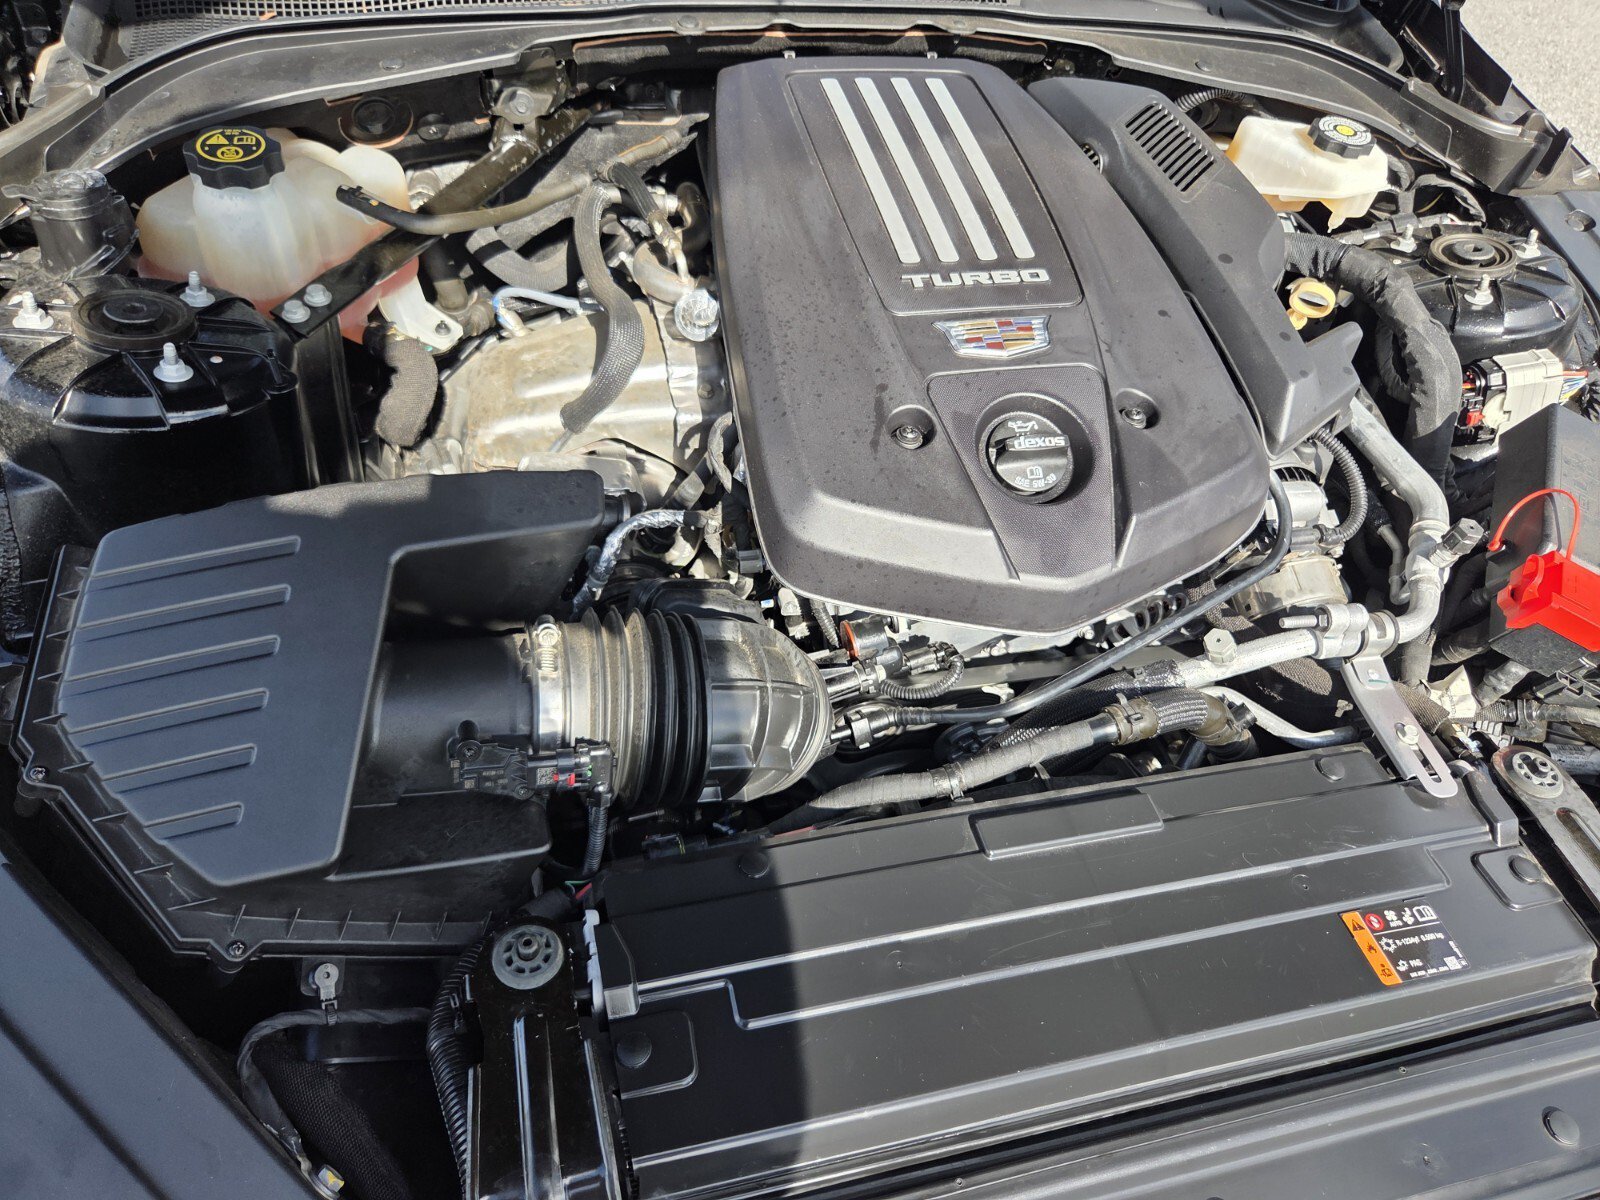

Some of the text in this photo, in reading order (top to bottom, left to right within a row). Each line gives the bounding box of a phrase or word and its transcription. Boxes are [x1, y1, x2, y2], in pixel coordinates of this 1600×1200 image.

[901, 268, 1050, 288] TURBO
[1014, 435, 1066, 449] dexos
[1015, 473, 1057, 488] SAE 5W-30
